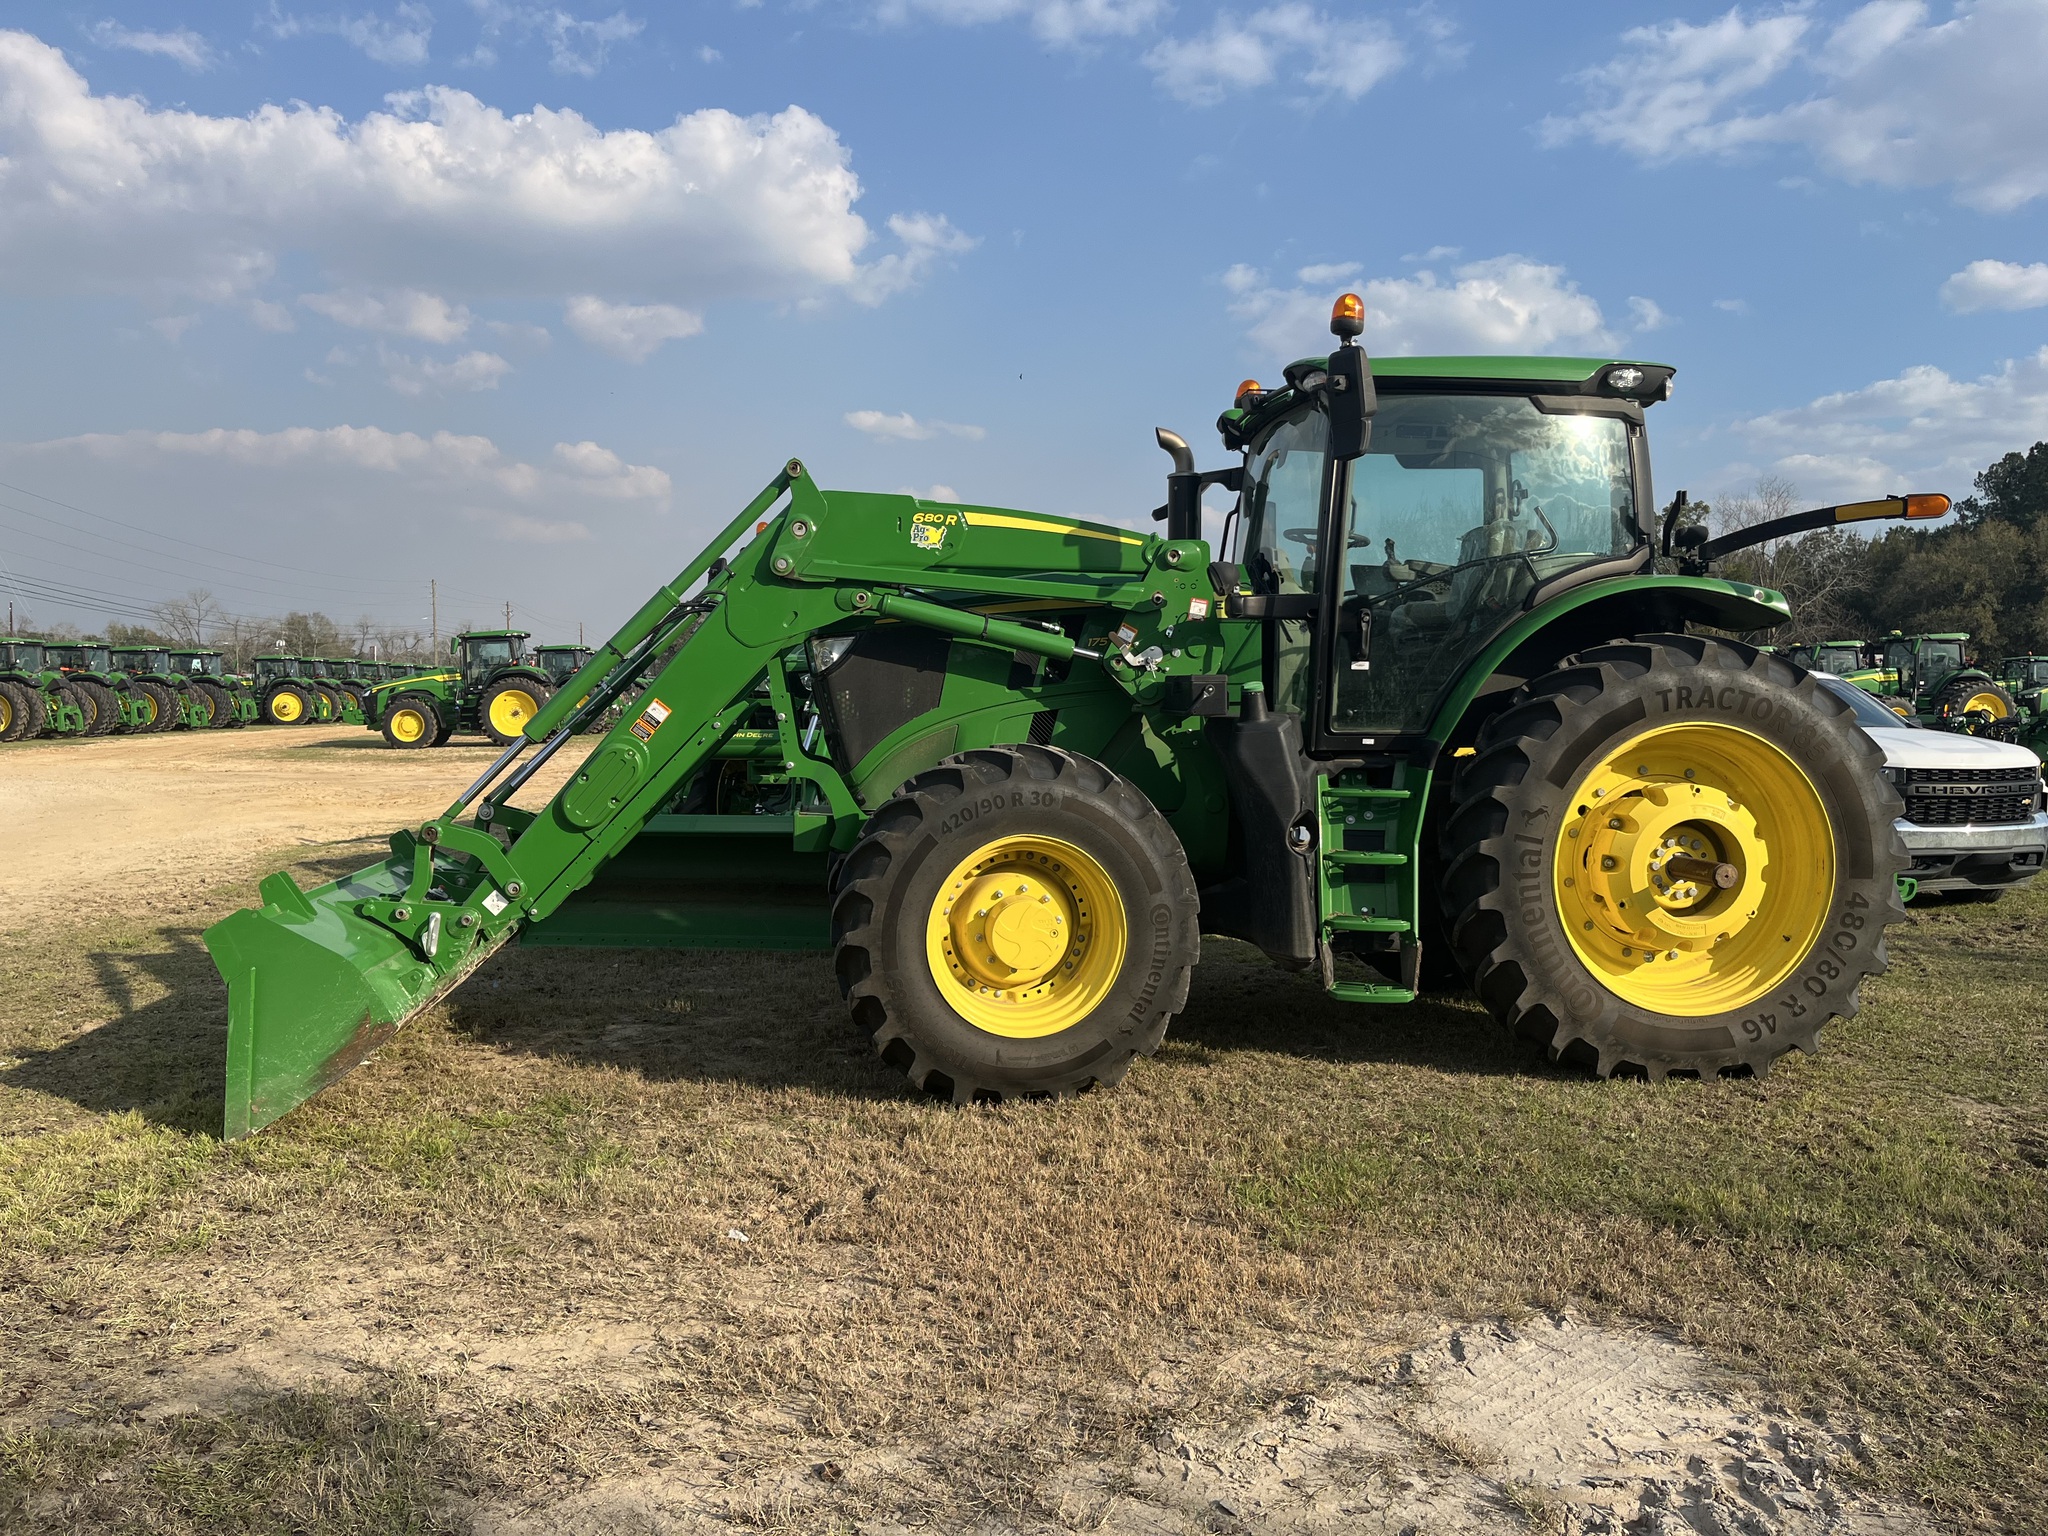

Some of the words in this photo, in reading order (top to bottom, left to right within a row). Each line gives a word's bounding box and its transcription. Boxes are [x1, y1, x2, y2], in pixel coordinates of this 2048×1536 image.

[912, 512, 944, 524] 680
[945, 514, 958, 526] R
[913, 533, 929, 541] Pro
[1087, 637, 1109, 647] 175
[1655, 685, 1793, 734] TRACTOR
[1793, 723, 1832, 762] 85
[1914, 784, 2038, 795] CHEVROLET
[941, 795, 1006, 836] 420/90
[1011, 792, 1024, 807] R
[1030, 791, 1054, 807] 30
[1512, 833, 1604, 1022] Continental
[1802, 892, 1870, 998] 480/80
[1126, 903, 1173, 1025] Continental
[1779, 994, 1807, 1018] R
[897, 1004, 969, 1072] TRACTOR
[1741, 1013, 1777, 1043] 46
